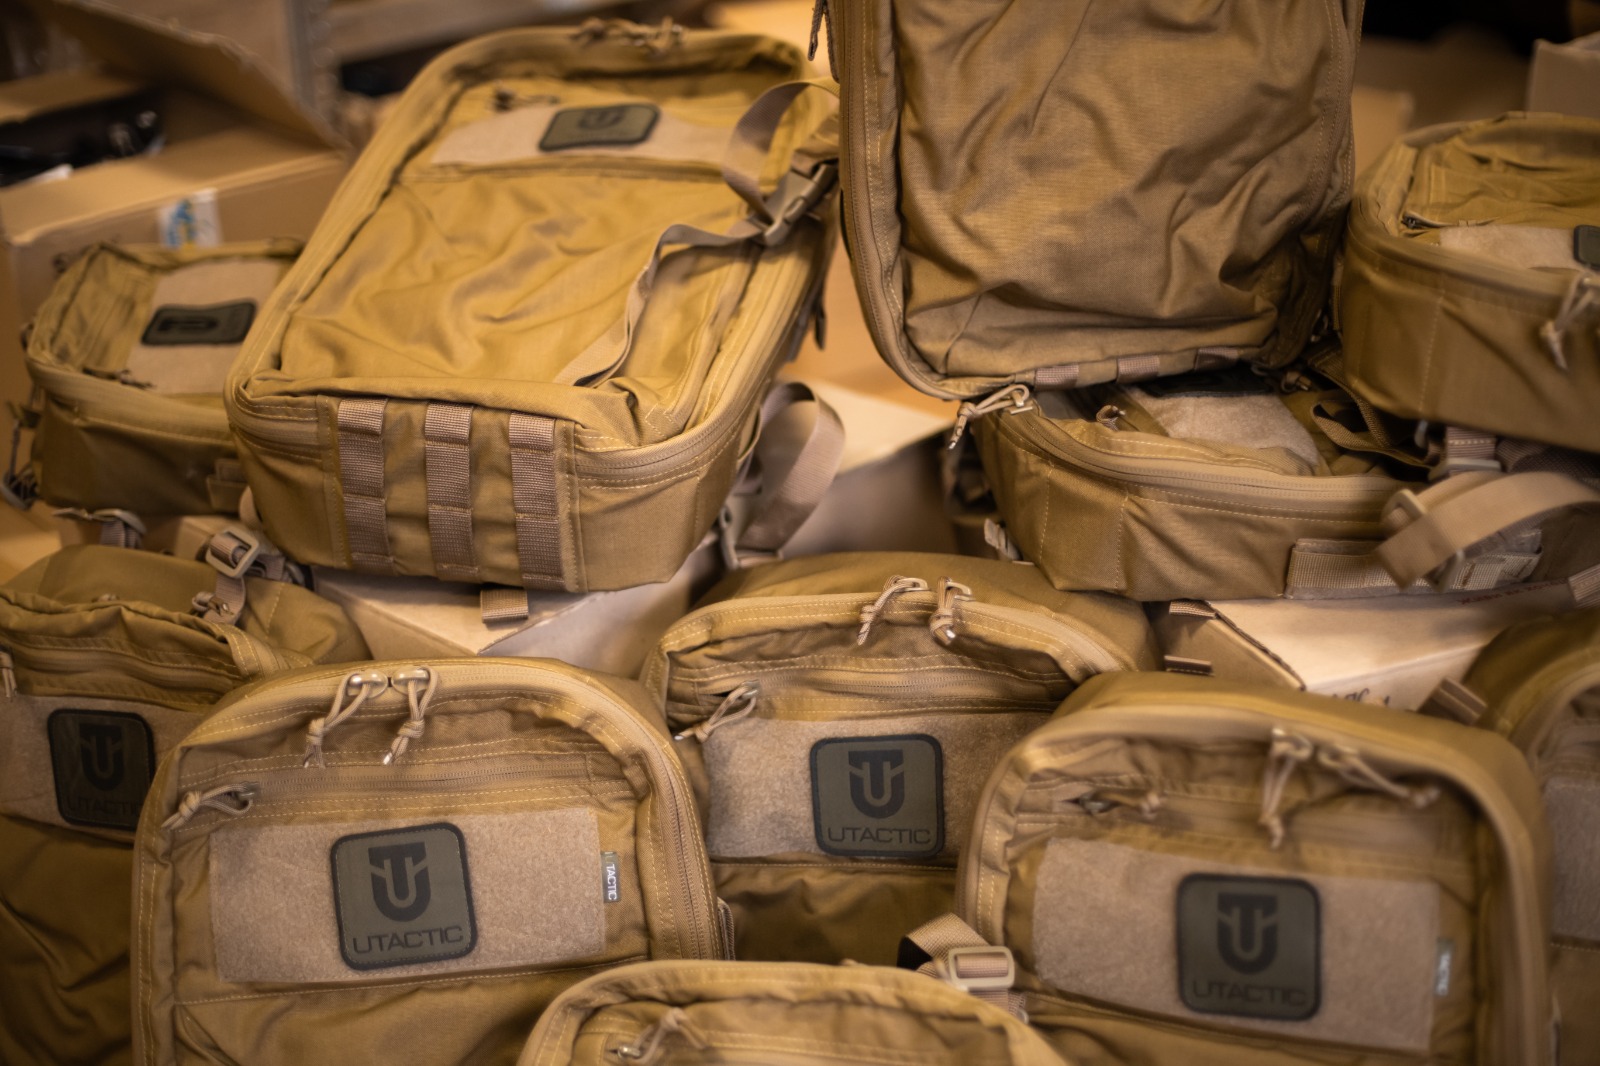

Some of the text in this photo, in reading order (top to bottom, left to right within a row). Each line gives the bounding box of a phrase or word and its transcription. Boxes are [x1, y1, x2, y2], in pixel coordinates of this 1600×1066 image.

[827, 827, 931, 844] UTACTIC
[353, 925, 463, 954] UTACTIC
[1193, 980, 1307, 1006] UTACTIC
